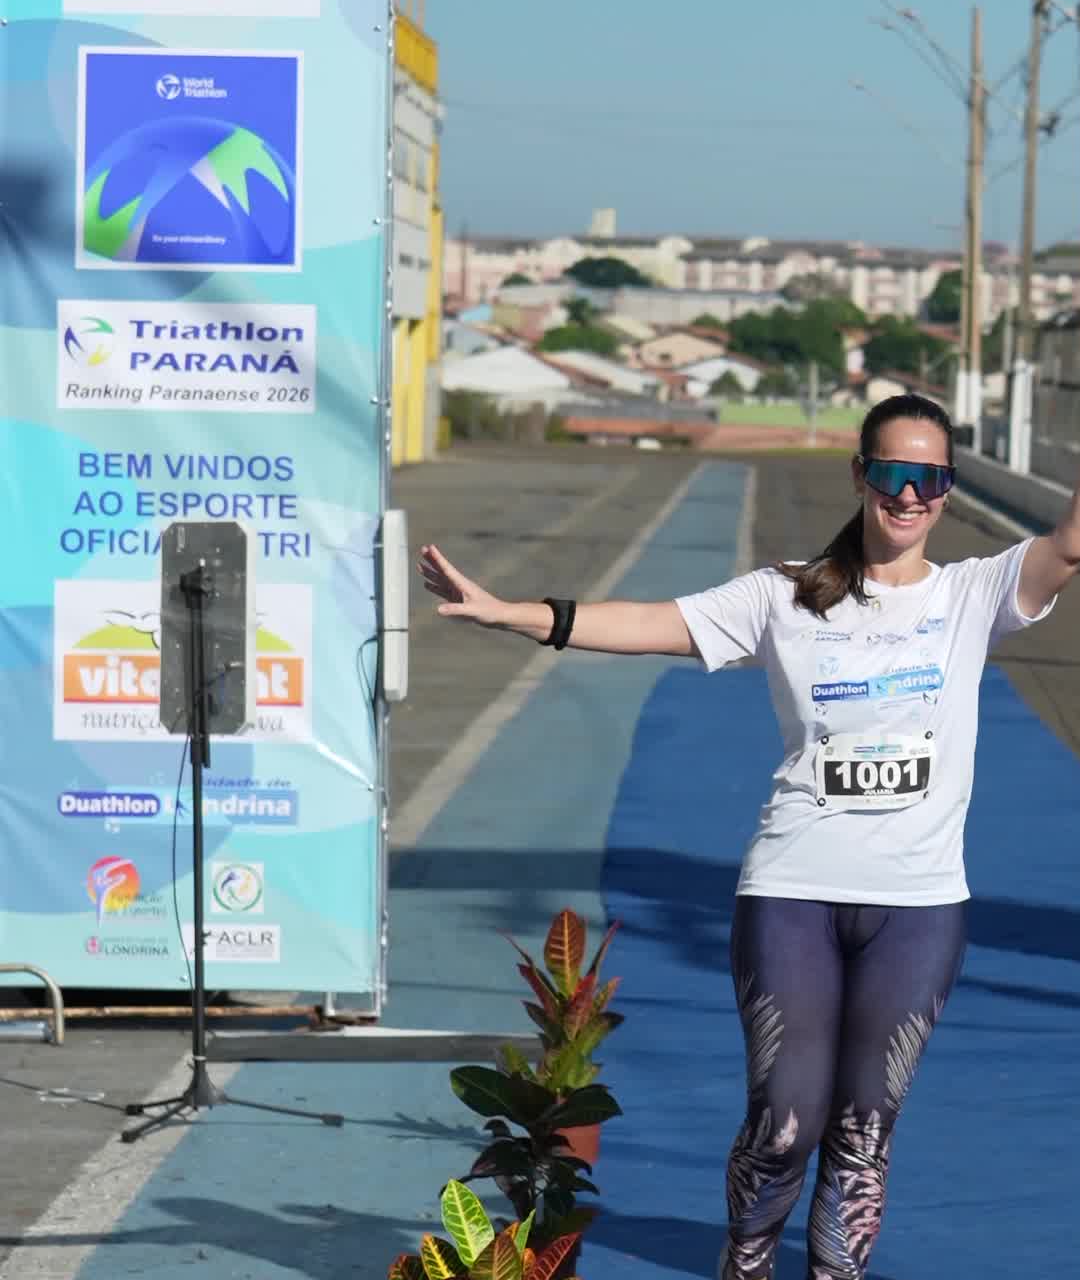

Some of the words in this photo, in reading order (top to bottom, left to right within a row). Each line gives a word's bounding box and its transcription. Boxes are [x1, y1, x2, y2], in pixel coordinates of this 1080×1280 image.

[129, 320, 304, 342] Triathlon
[130, 350, 299, 374] PARANÁ
[65, 383, 143, 404] Ranking
[149, 385, 260, 403] Paranaense
[266, 387, 310, 403] 2026
[79, 452, 152, 479] BEM
[164, 454, 294, 481] VINDOS
[74, 491, 124, 516] AO
[137, 493, 298, 519] ESPORTE
[60, 528, 161, 554] OFICI
[812, 684, 868, 698] Duathlon
[835, 758, 918, 790] 1001
[60, 794, 157, 814] Duathlon
[105, 944, 169, 956] LONDRINA
